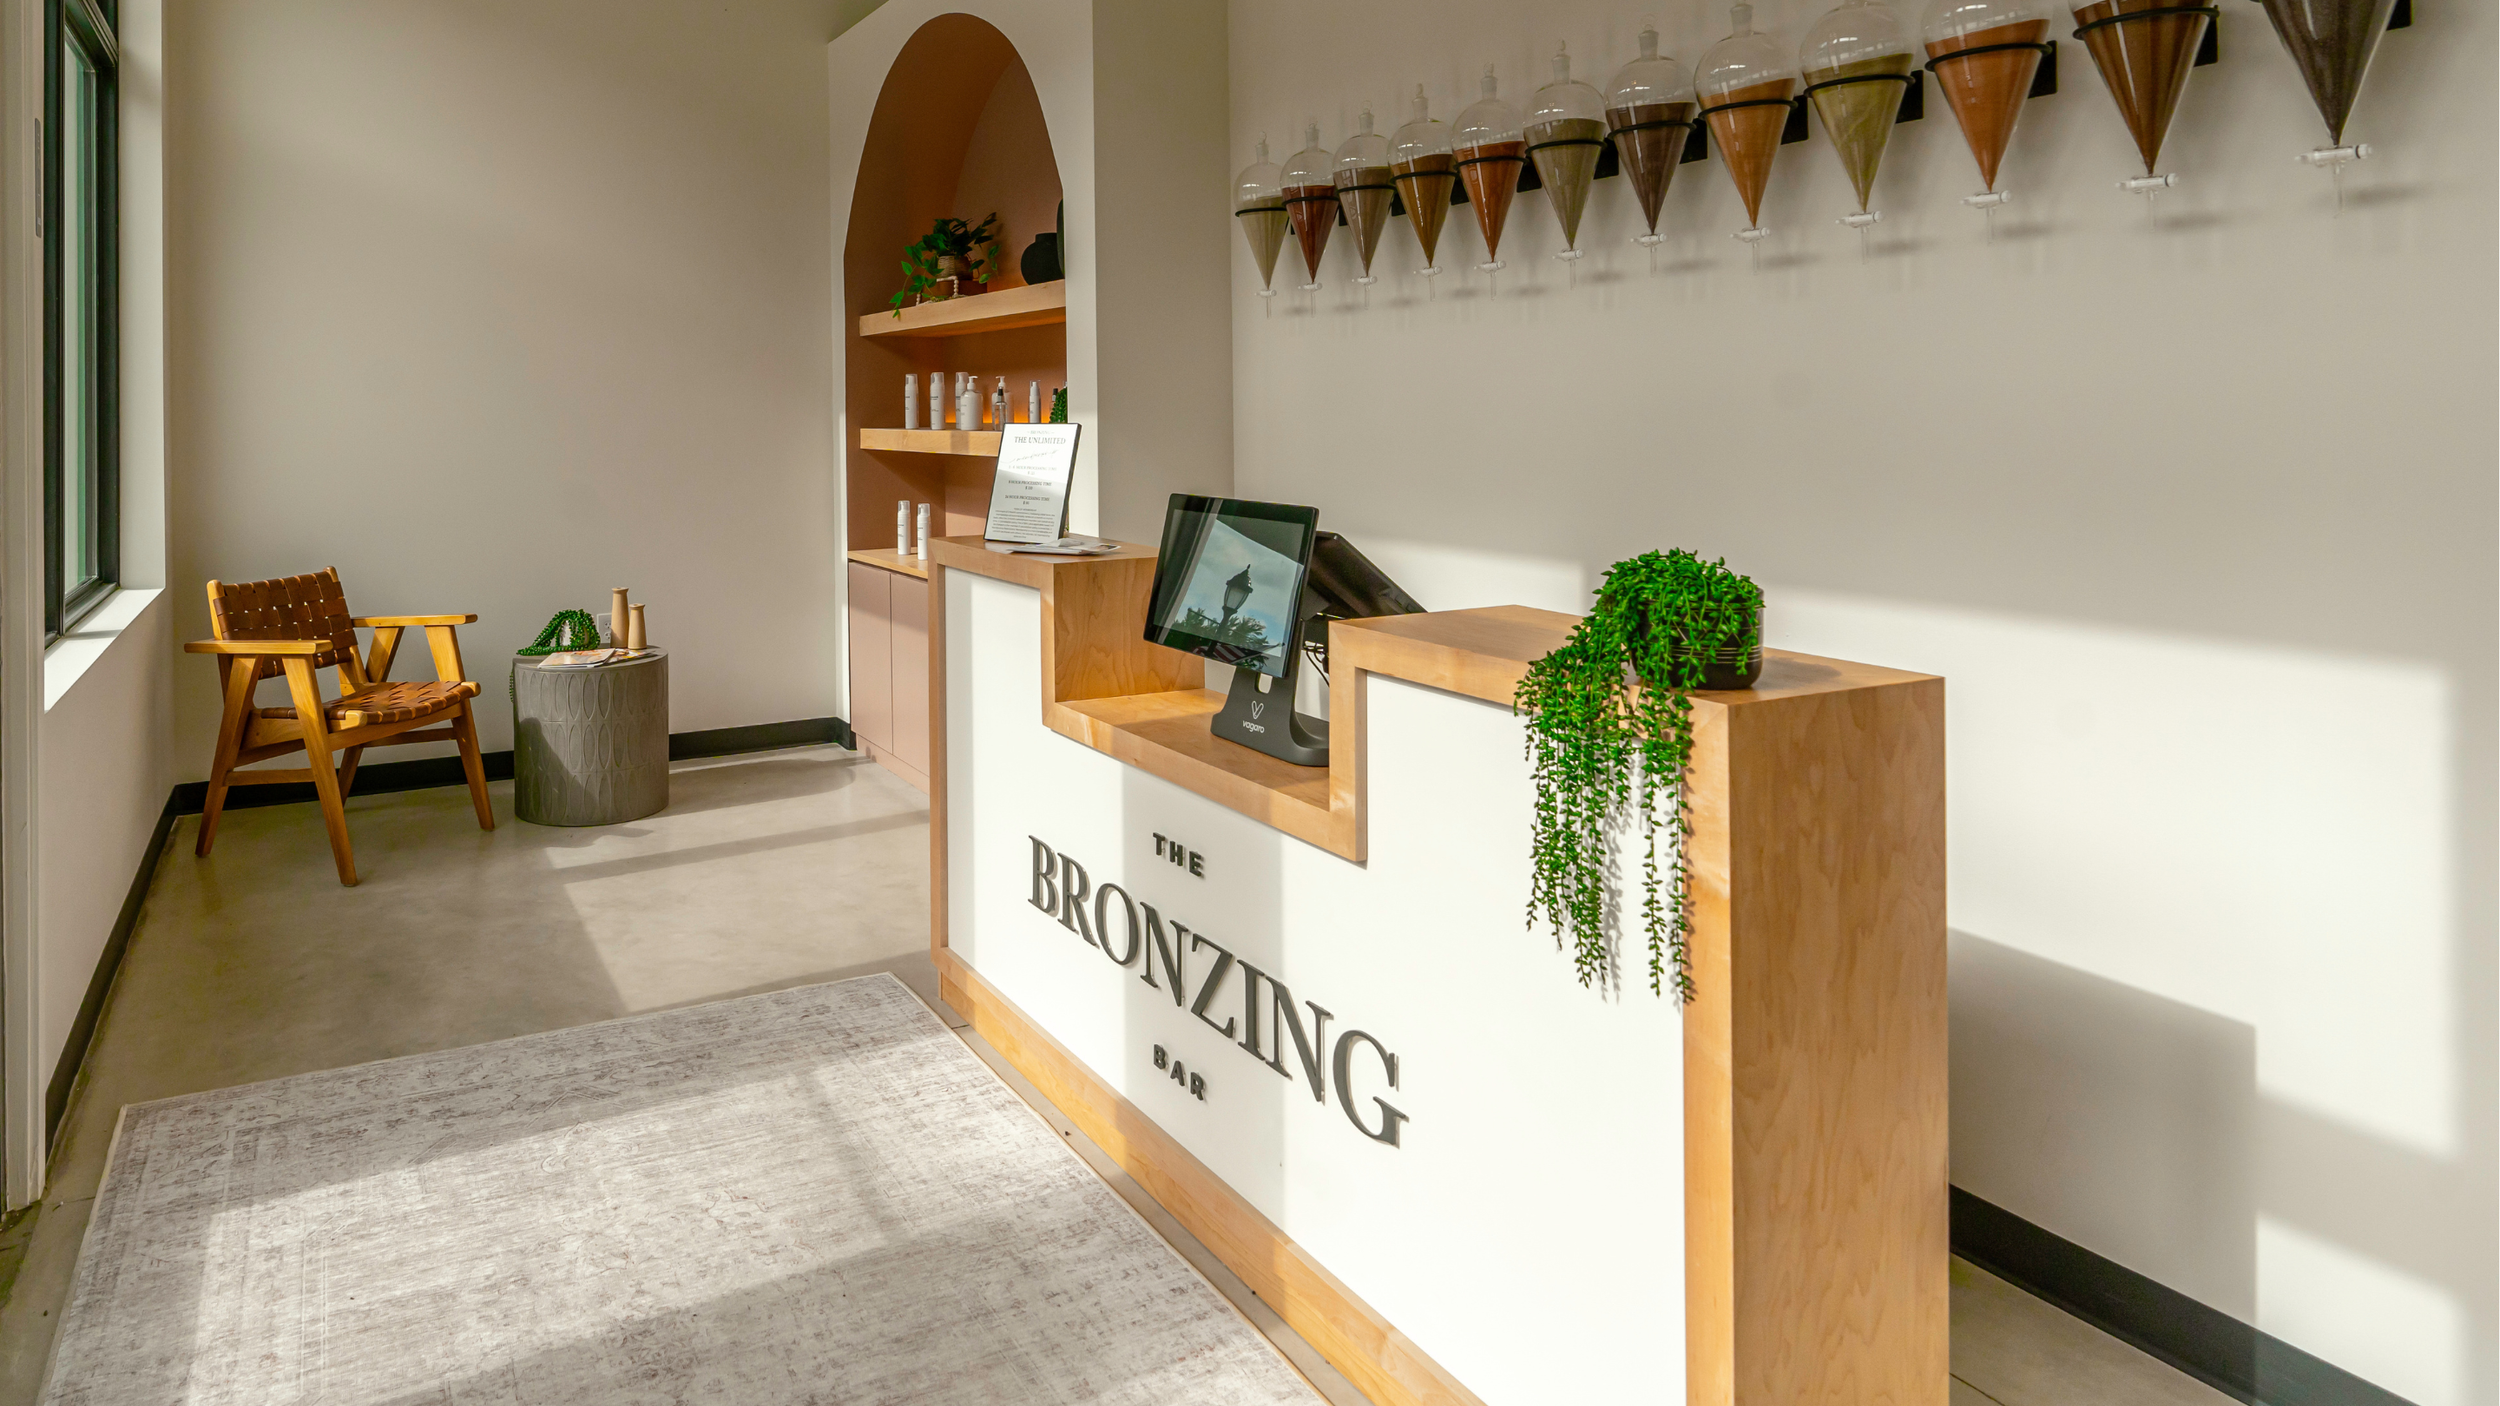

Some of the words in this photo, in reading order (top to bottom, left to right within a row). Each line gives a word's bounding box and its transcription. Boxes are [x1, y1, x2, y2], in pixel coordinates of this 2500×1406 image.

[1243, 720, 1265, 733] vagaro
[1153, 832, 1204, 877] THE
[1027, 834, 1407, 1146] BRONZING
[1153, 1044, 1206, 1101] BAR
